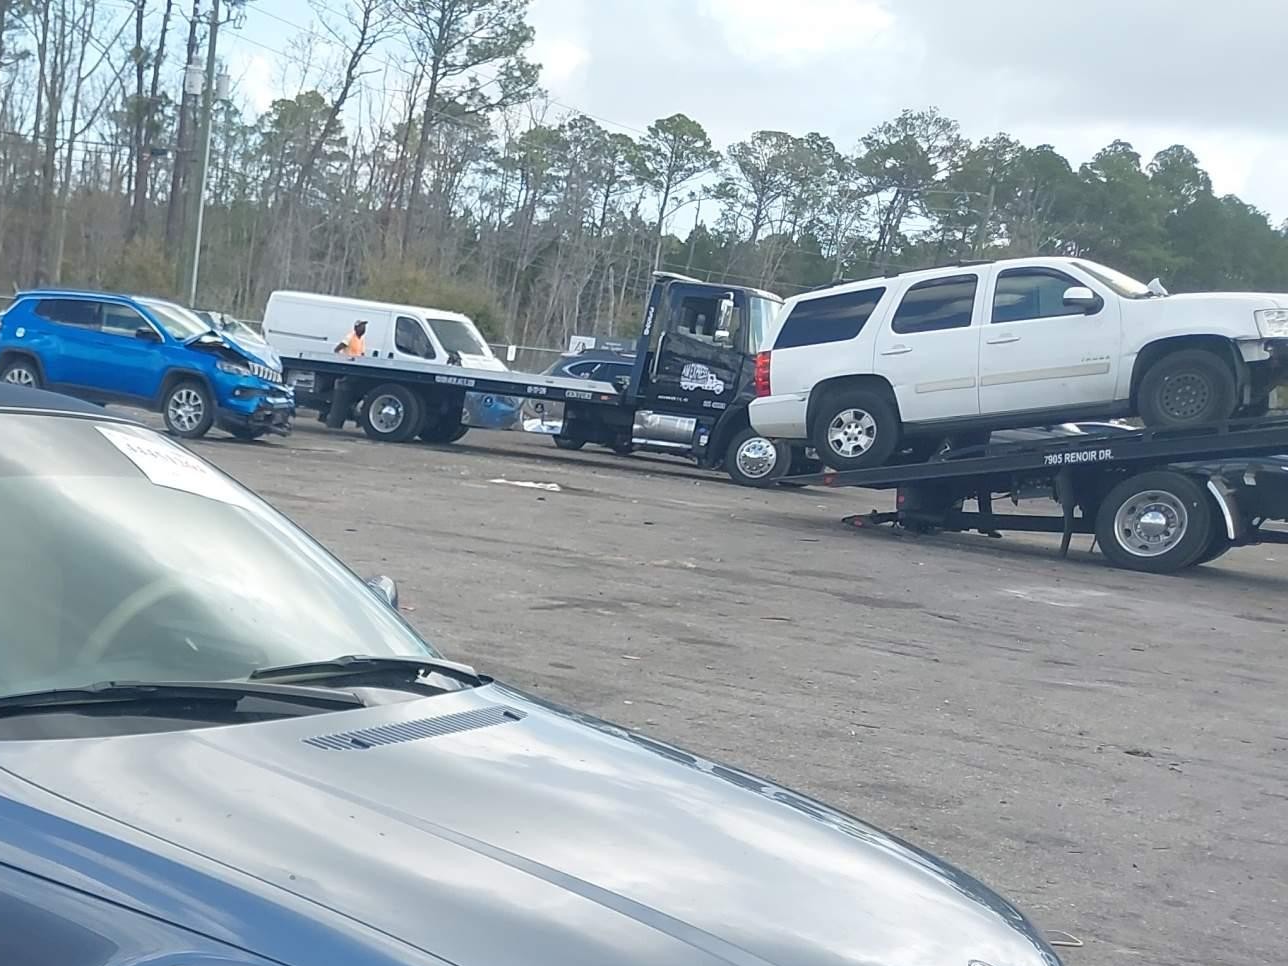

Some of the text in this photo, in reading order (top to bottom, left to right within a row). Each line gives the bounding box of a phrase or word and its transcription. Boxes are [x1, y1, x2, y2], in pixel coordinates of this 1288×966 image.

[1044, 449, 1114, 465] 7905 RENOIR DR.
